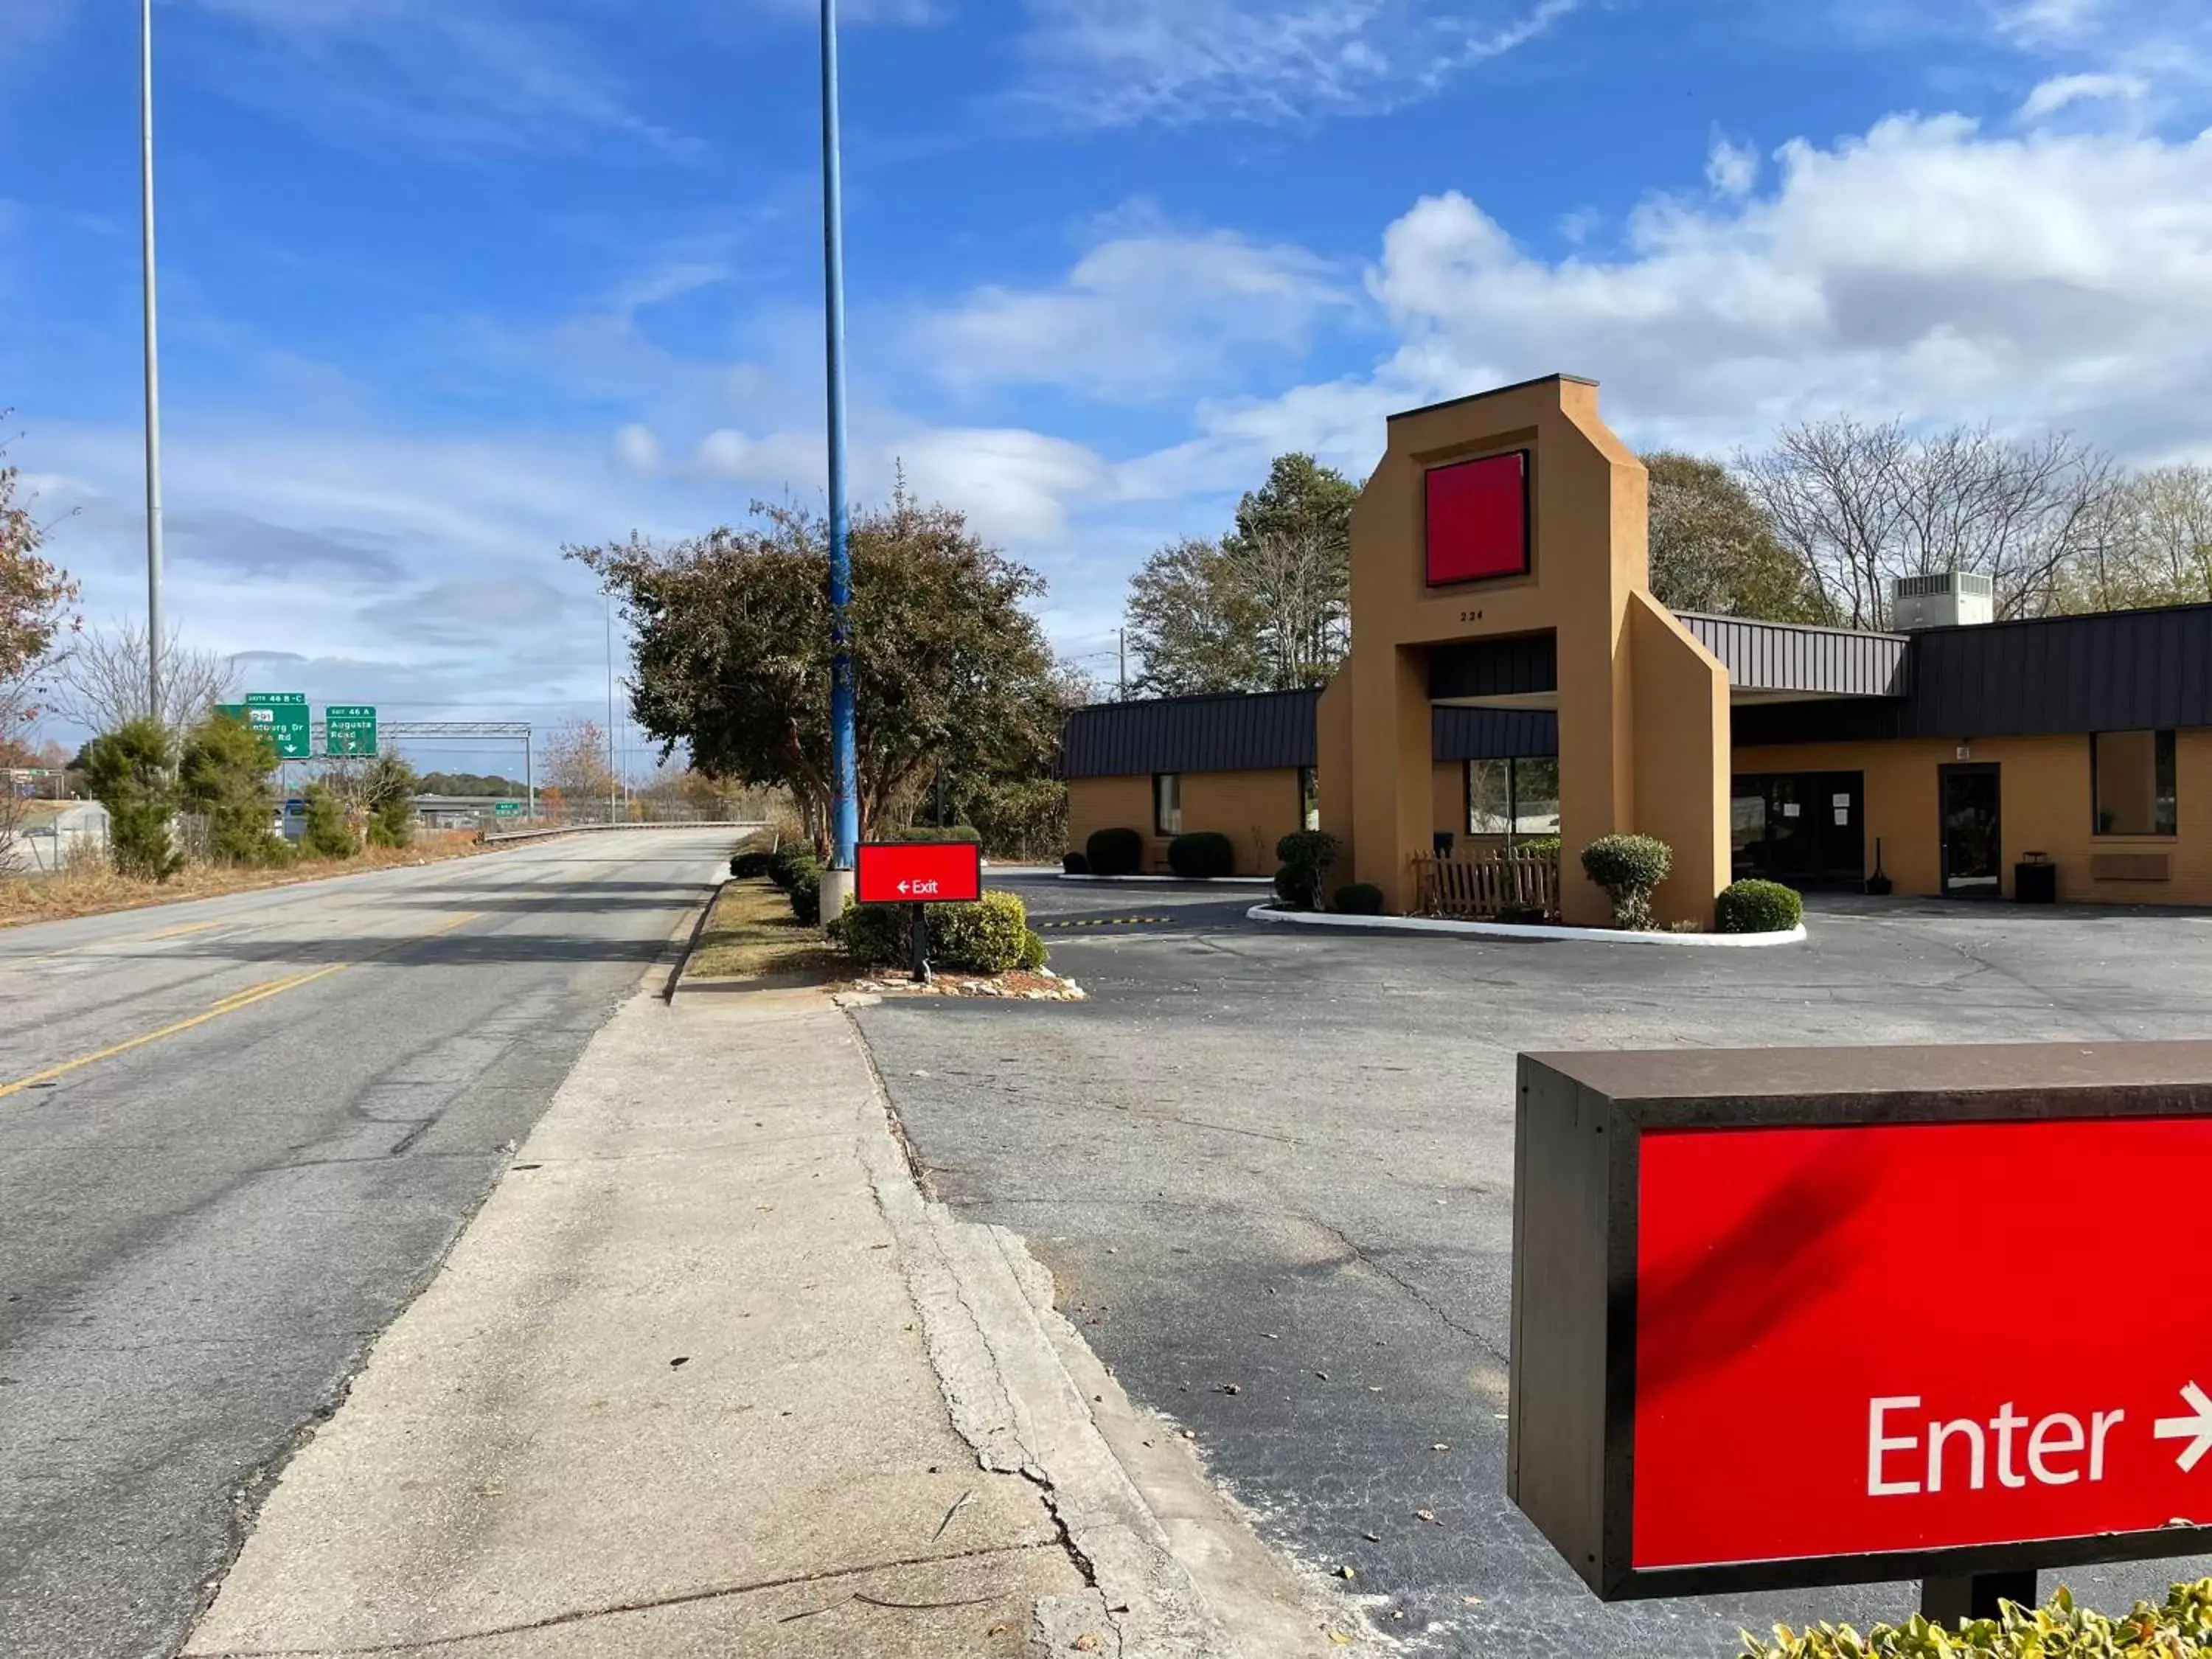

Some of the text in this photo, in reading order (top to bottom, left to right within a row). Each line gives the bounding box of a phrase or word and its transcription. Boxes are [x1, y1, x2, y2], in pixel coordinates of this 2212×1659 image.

[331, 721, 372, 730] Augusta
[912, 880, 938, 894] Exit
[1868, 1395, 2124, 1495] Enter
